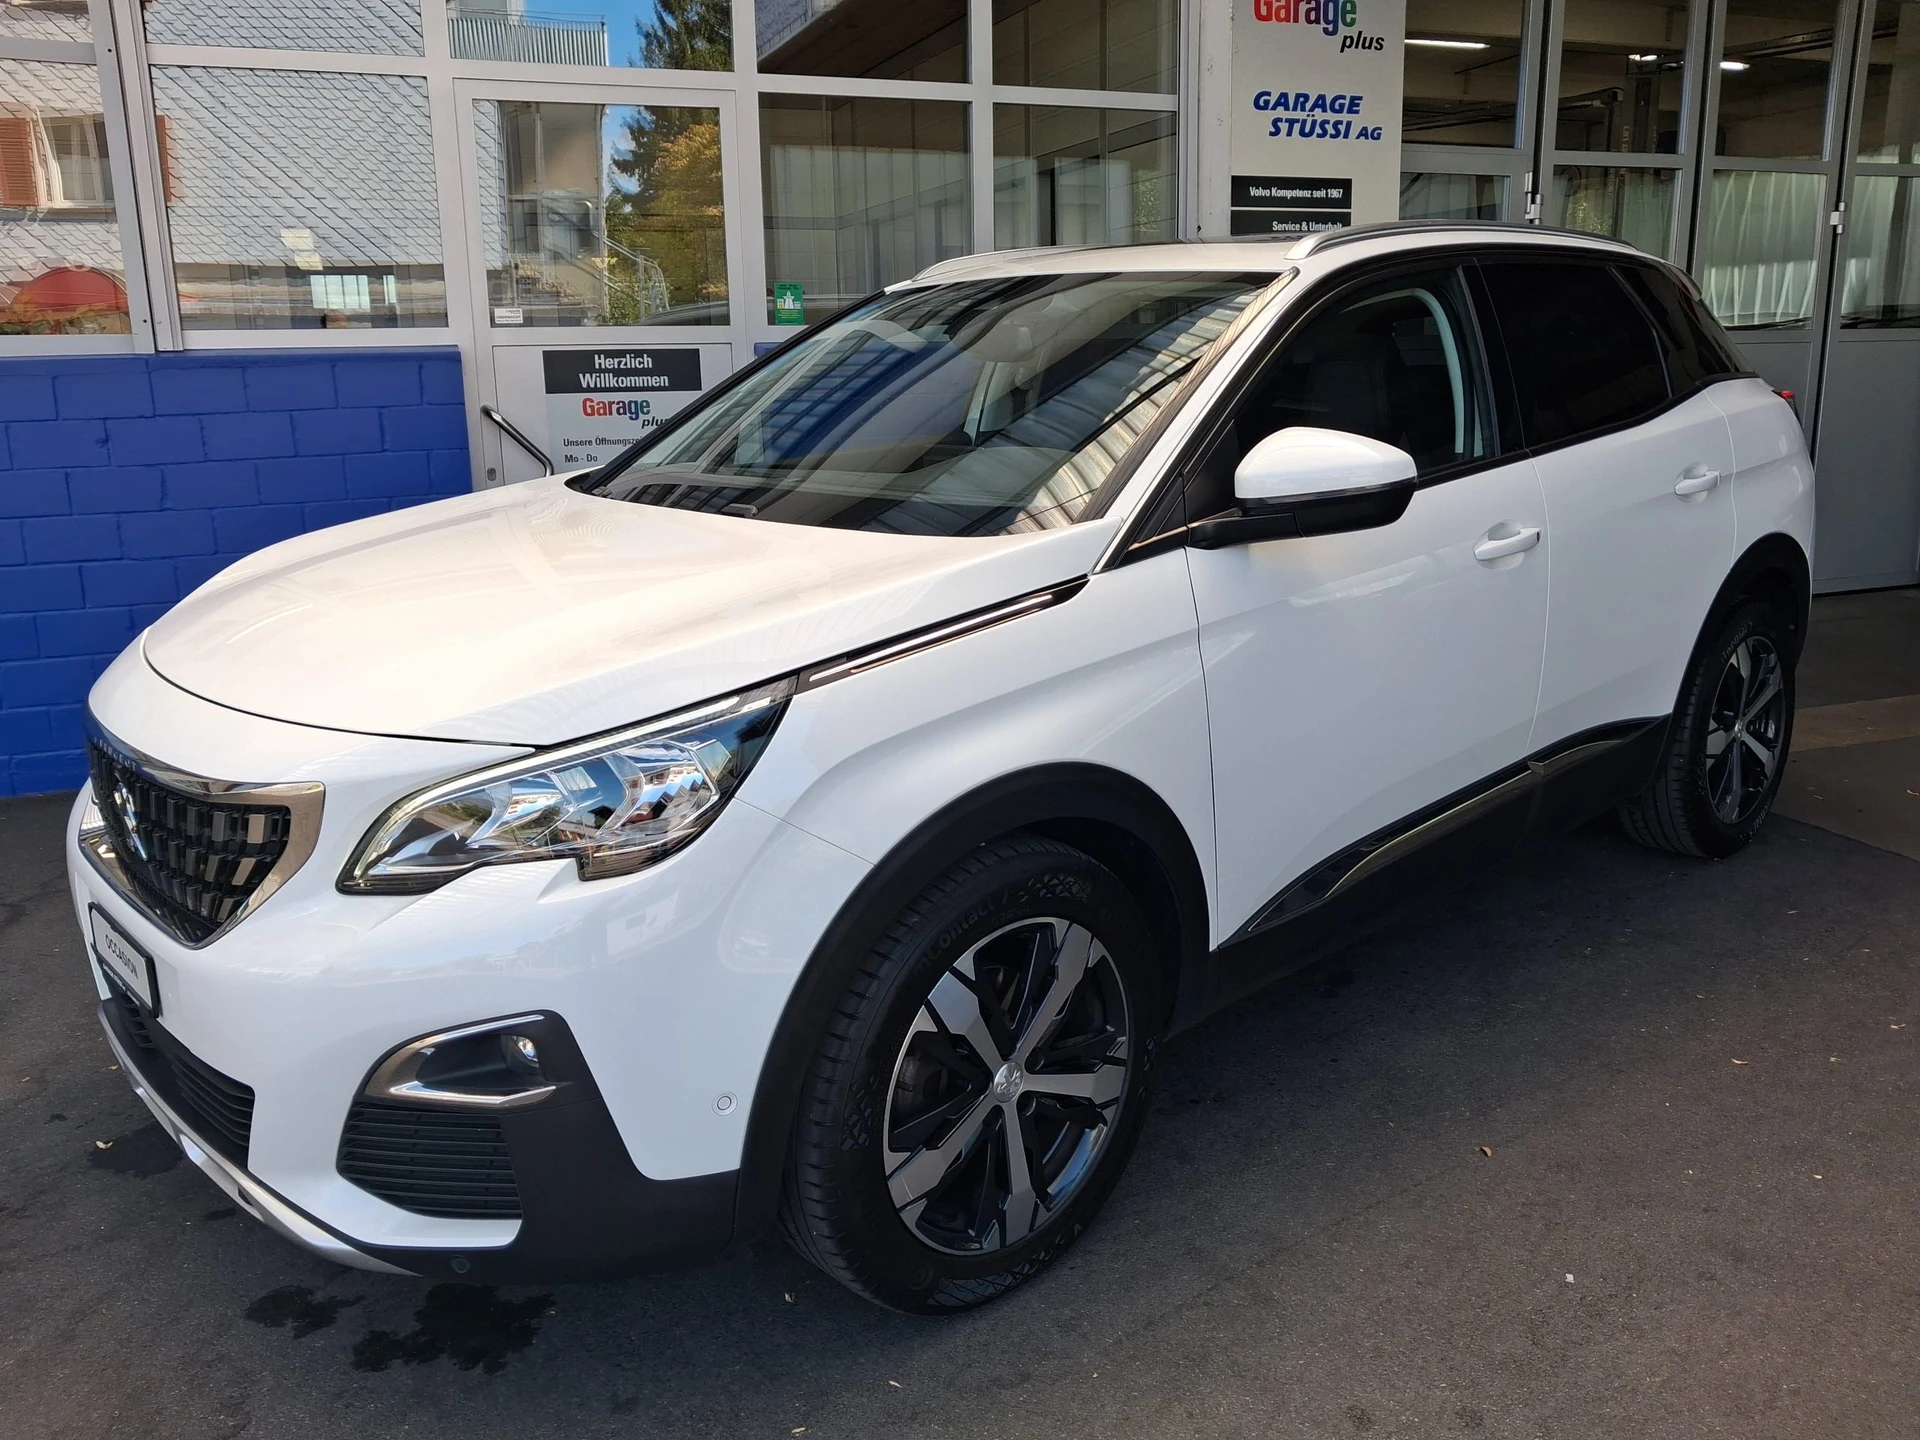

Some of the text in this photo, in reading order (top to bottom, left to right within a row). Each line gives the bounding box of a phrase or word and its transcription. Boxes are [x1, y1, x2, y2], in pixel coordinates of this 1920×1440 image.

[1253, 0, 1357, 36] Garage
[1340, 31, 1385, 53] plus
[1252, 90, 1364, 115] GARAGE
[1268, 113, 1383, 141] STÜSSI AG
[1249, 186, 1343, 200] Volvo Kompetenz seit 1967
[1272, 220, 1301, 232] Service
[1301, 221, 1308, 231] &
[594, 353, 653, 369] Herzlich
[579, 372, 669, 389] Willkommen
[582, 397, 651, 421] Garage
[563, 437, 593, 447] Unsere
[564, 454, 579, 463] Mo
[586, 453, 598, 463] Do
[104, 933, 139, 980] OCCASION
